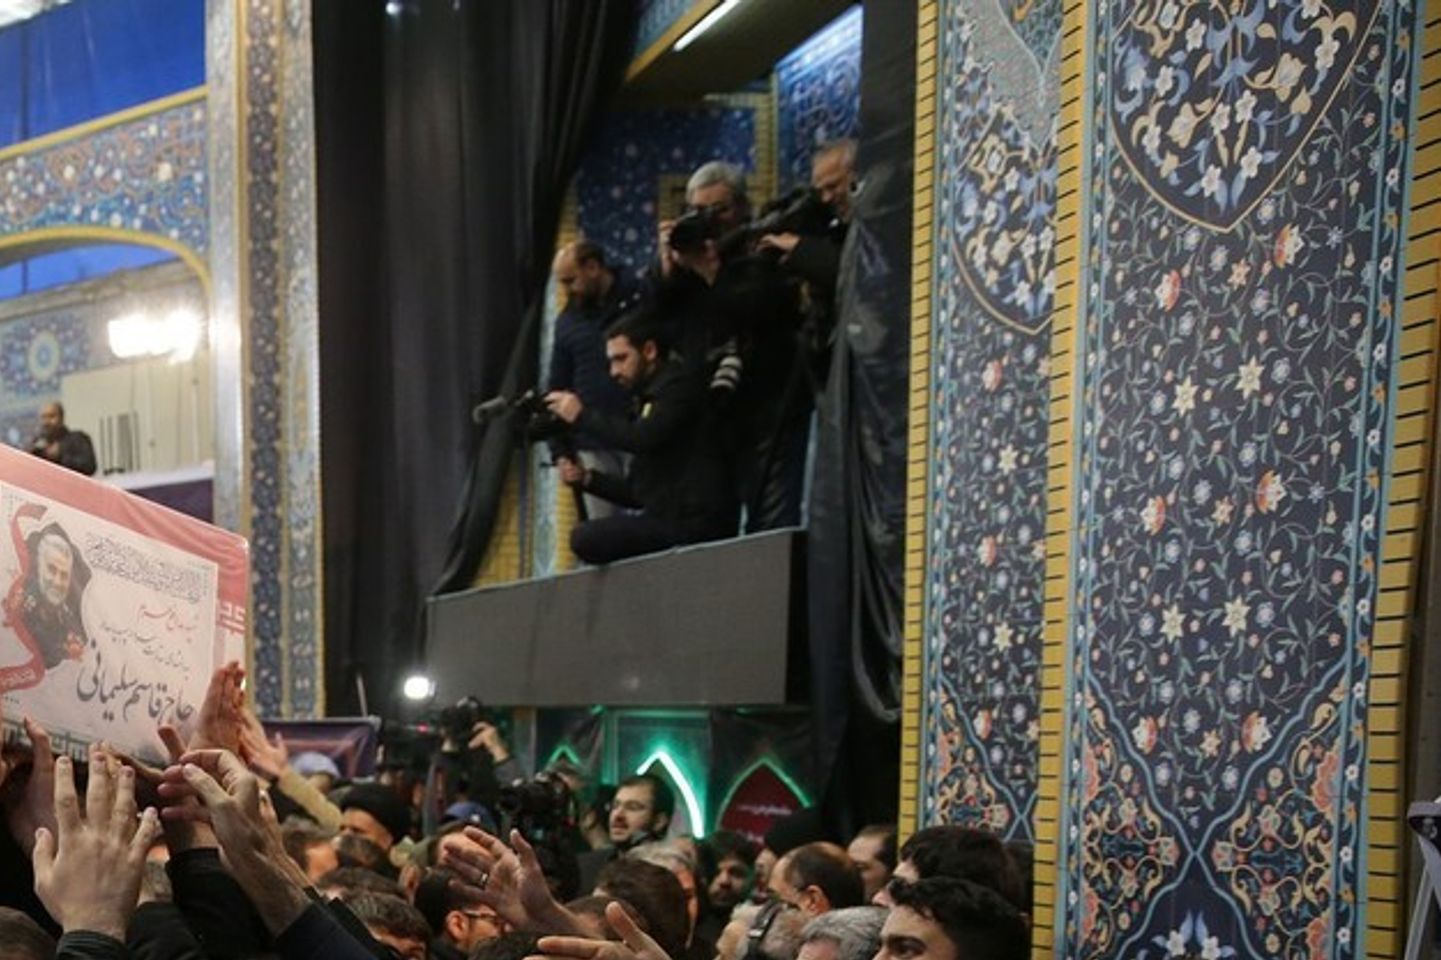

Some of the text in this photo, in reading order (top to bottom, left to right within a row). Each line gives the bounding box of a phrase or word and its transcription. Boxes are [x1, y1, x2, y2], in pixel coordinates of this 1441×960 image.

[76, 638, 139, 723] سلیمانی
[123, 681, 168, 723] قاسم
[157, 684, 195, 726] حاج
